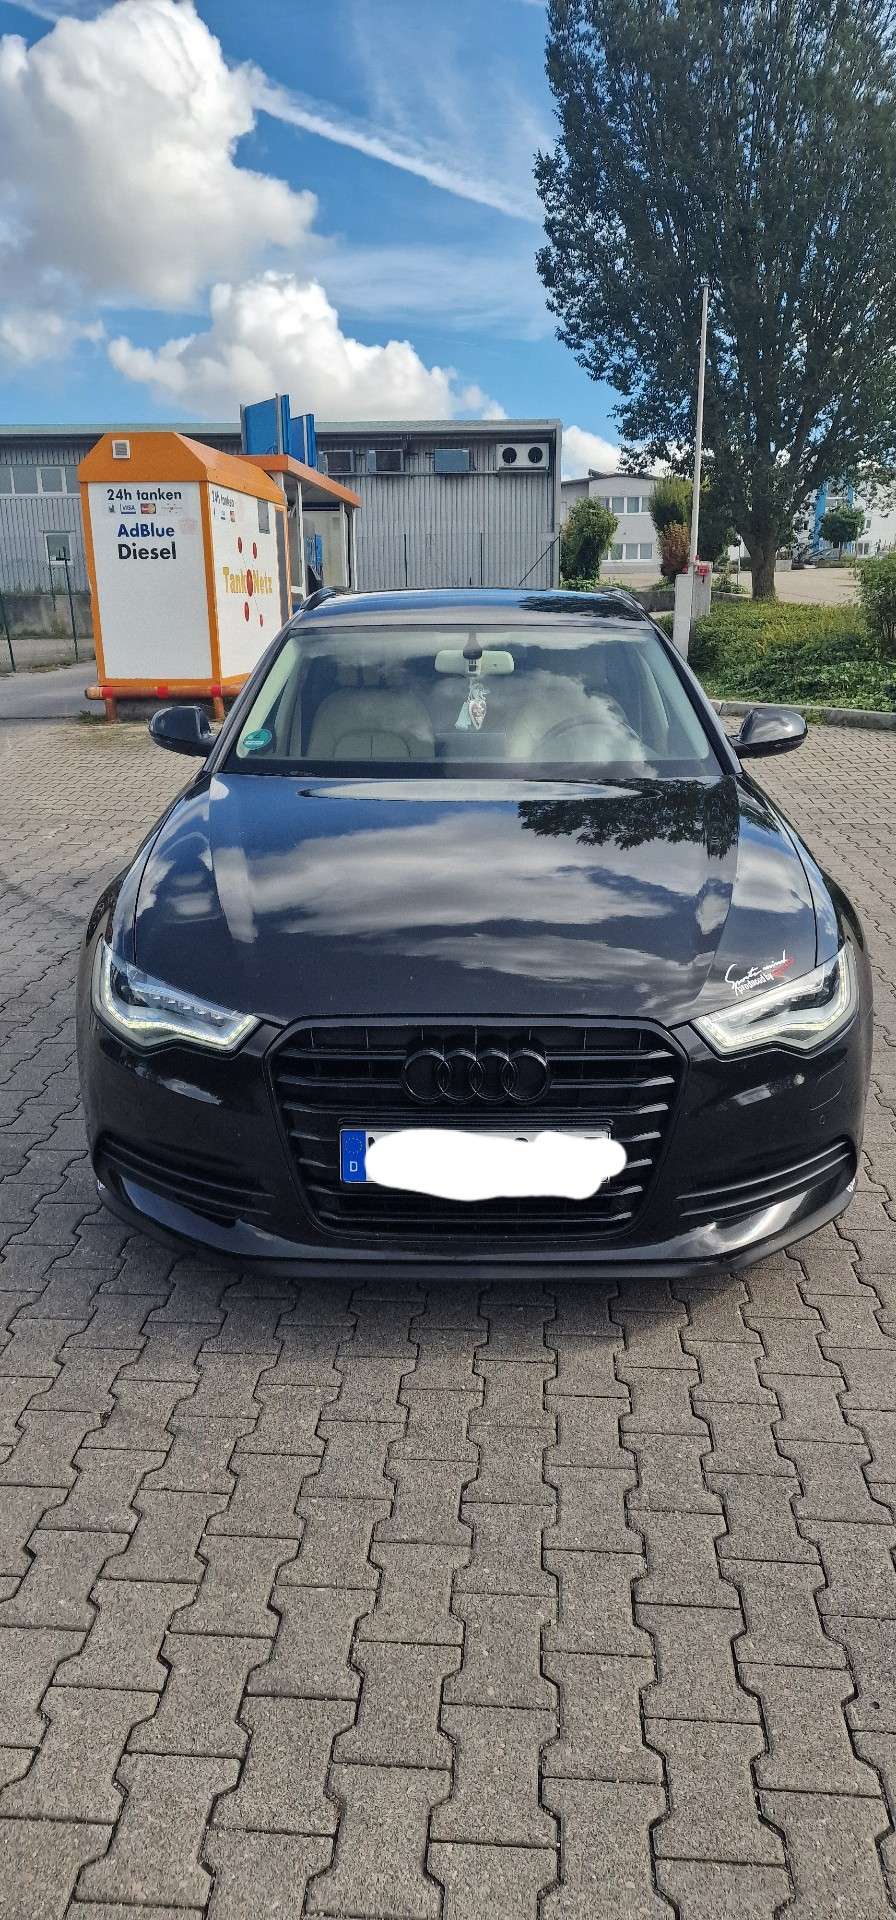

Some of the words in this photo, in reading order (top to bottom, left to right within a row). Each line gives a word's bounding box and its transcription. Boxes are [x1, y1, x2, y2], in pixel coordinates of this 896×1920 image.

[107, 488, 132, 500] 24h
[136, 487, 182, 501] tanken
[118, 522, 175, 537] AdBlue
[118, 541, 176, 559] Diesel
[349, 1160, 358, 1172] D
